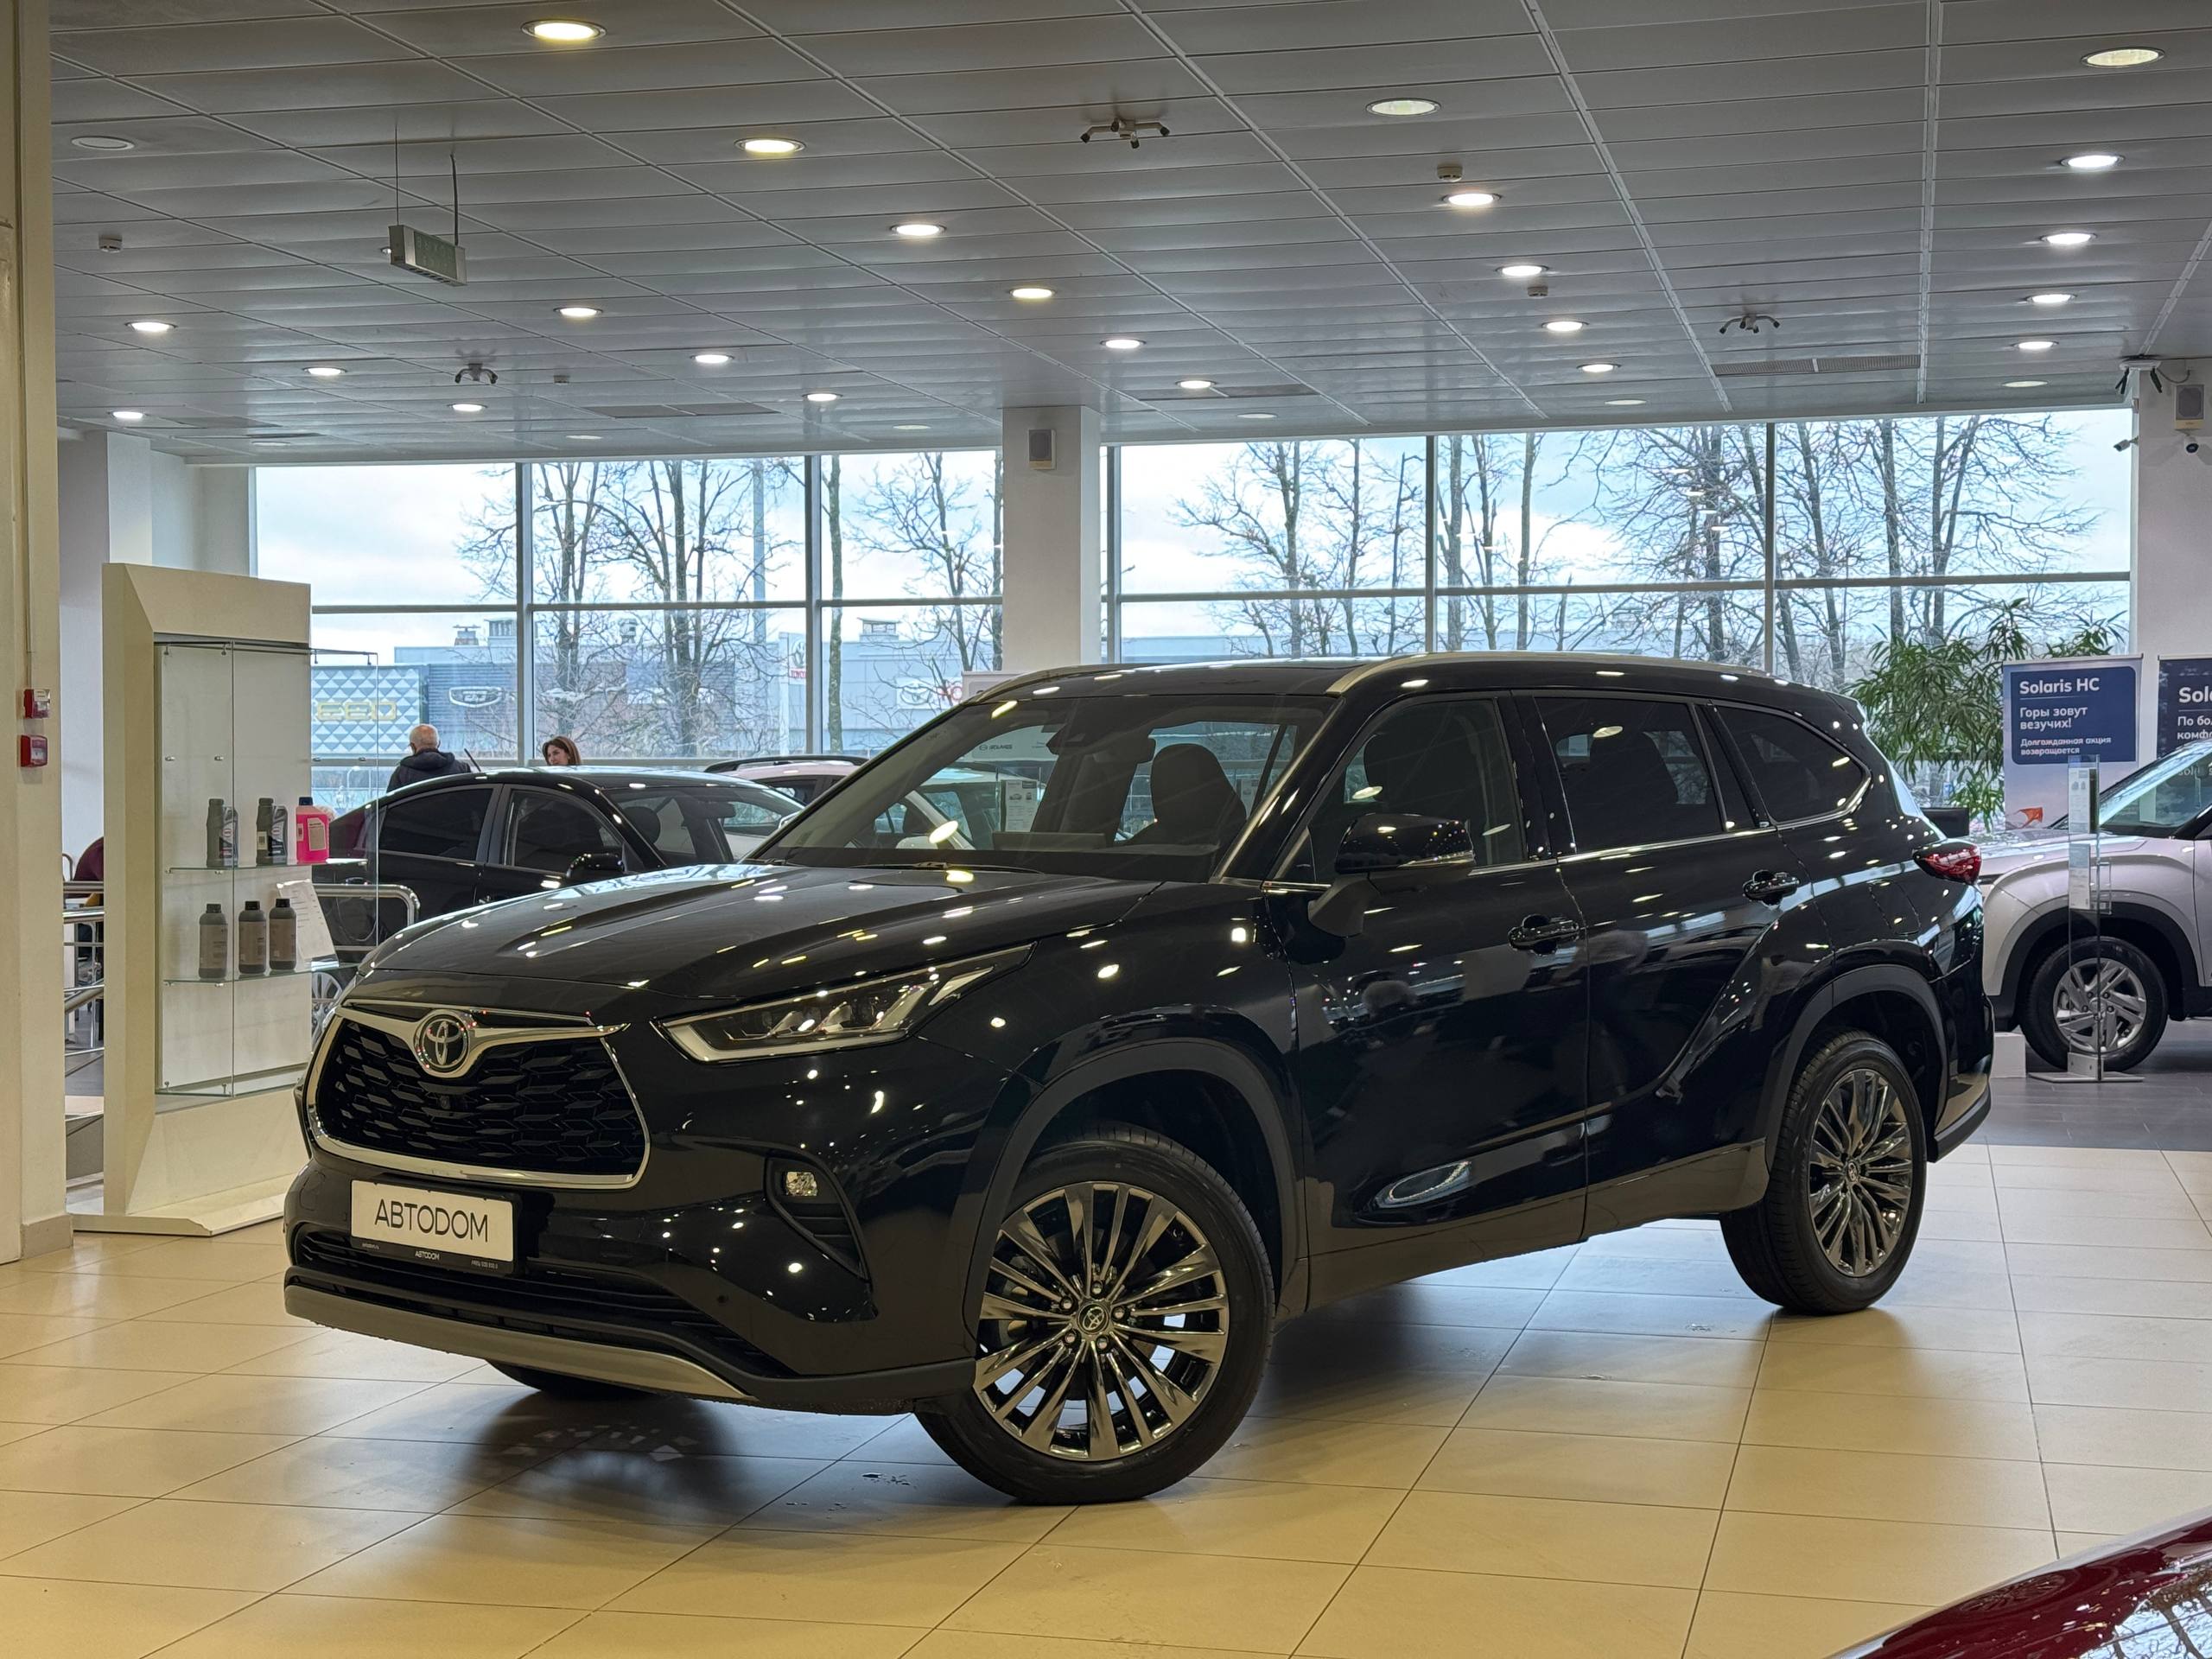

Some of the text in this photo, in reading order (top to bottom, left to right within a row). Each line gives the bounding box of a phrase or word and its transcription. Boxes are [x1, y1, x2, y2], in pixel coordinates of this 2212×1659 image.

[2019, 677, 2100, 695] Solaris HC
[2019, 707, 2088, 720] Горы зовут
[2020, 718, 2072, 732] везучих!
[2177, 715, 2212, 727] По бо
[2020, 738, 2083, 747] Долгожданная
